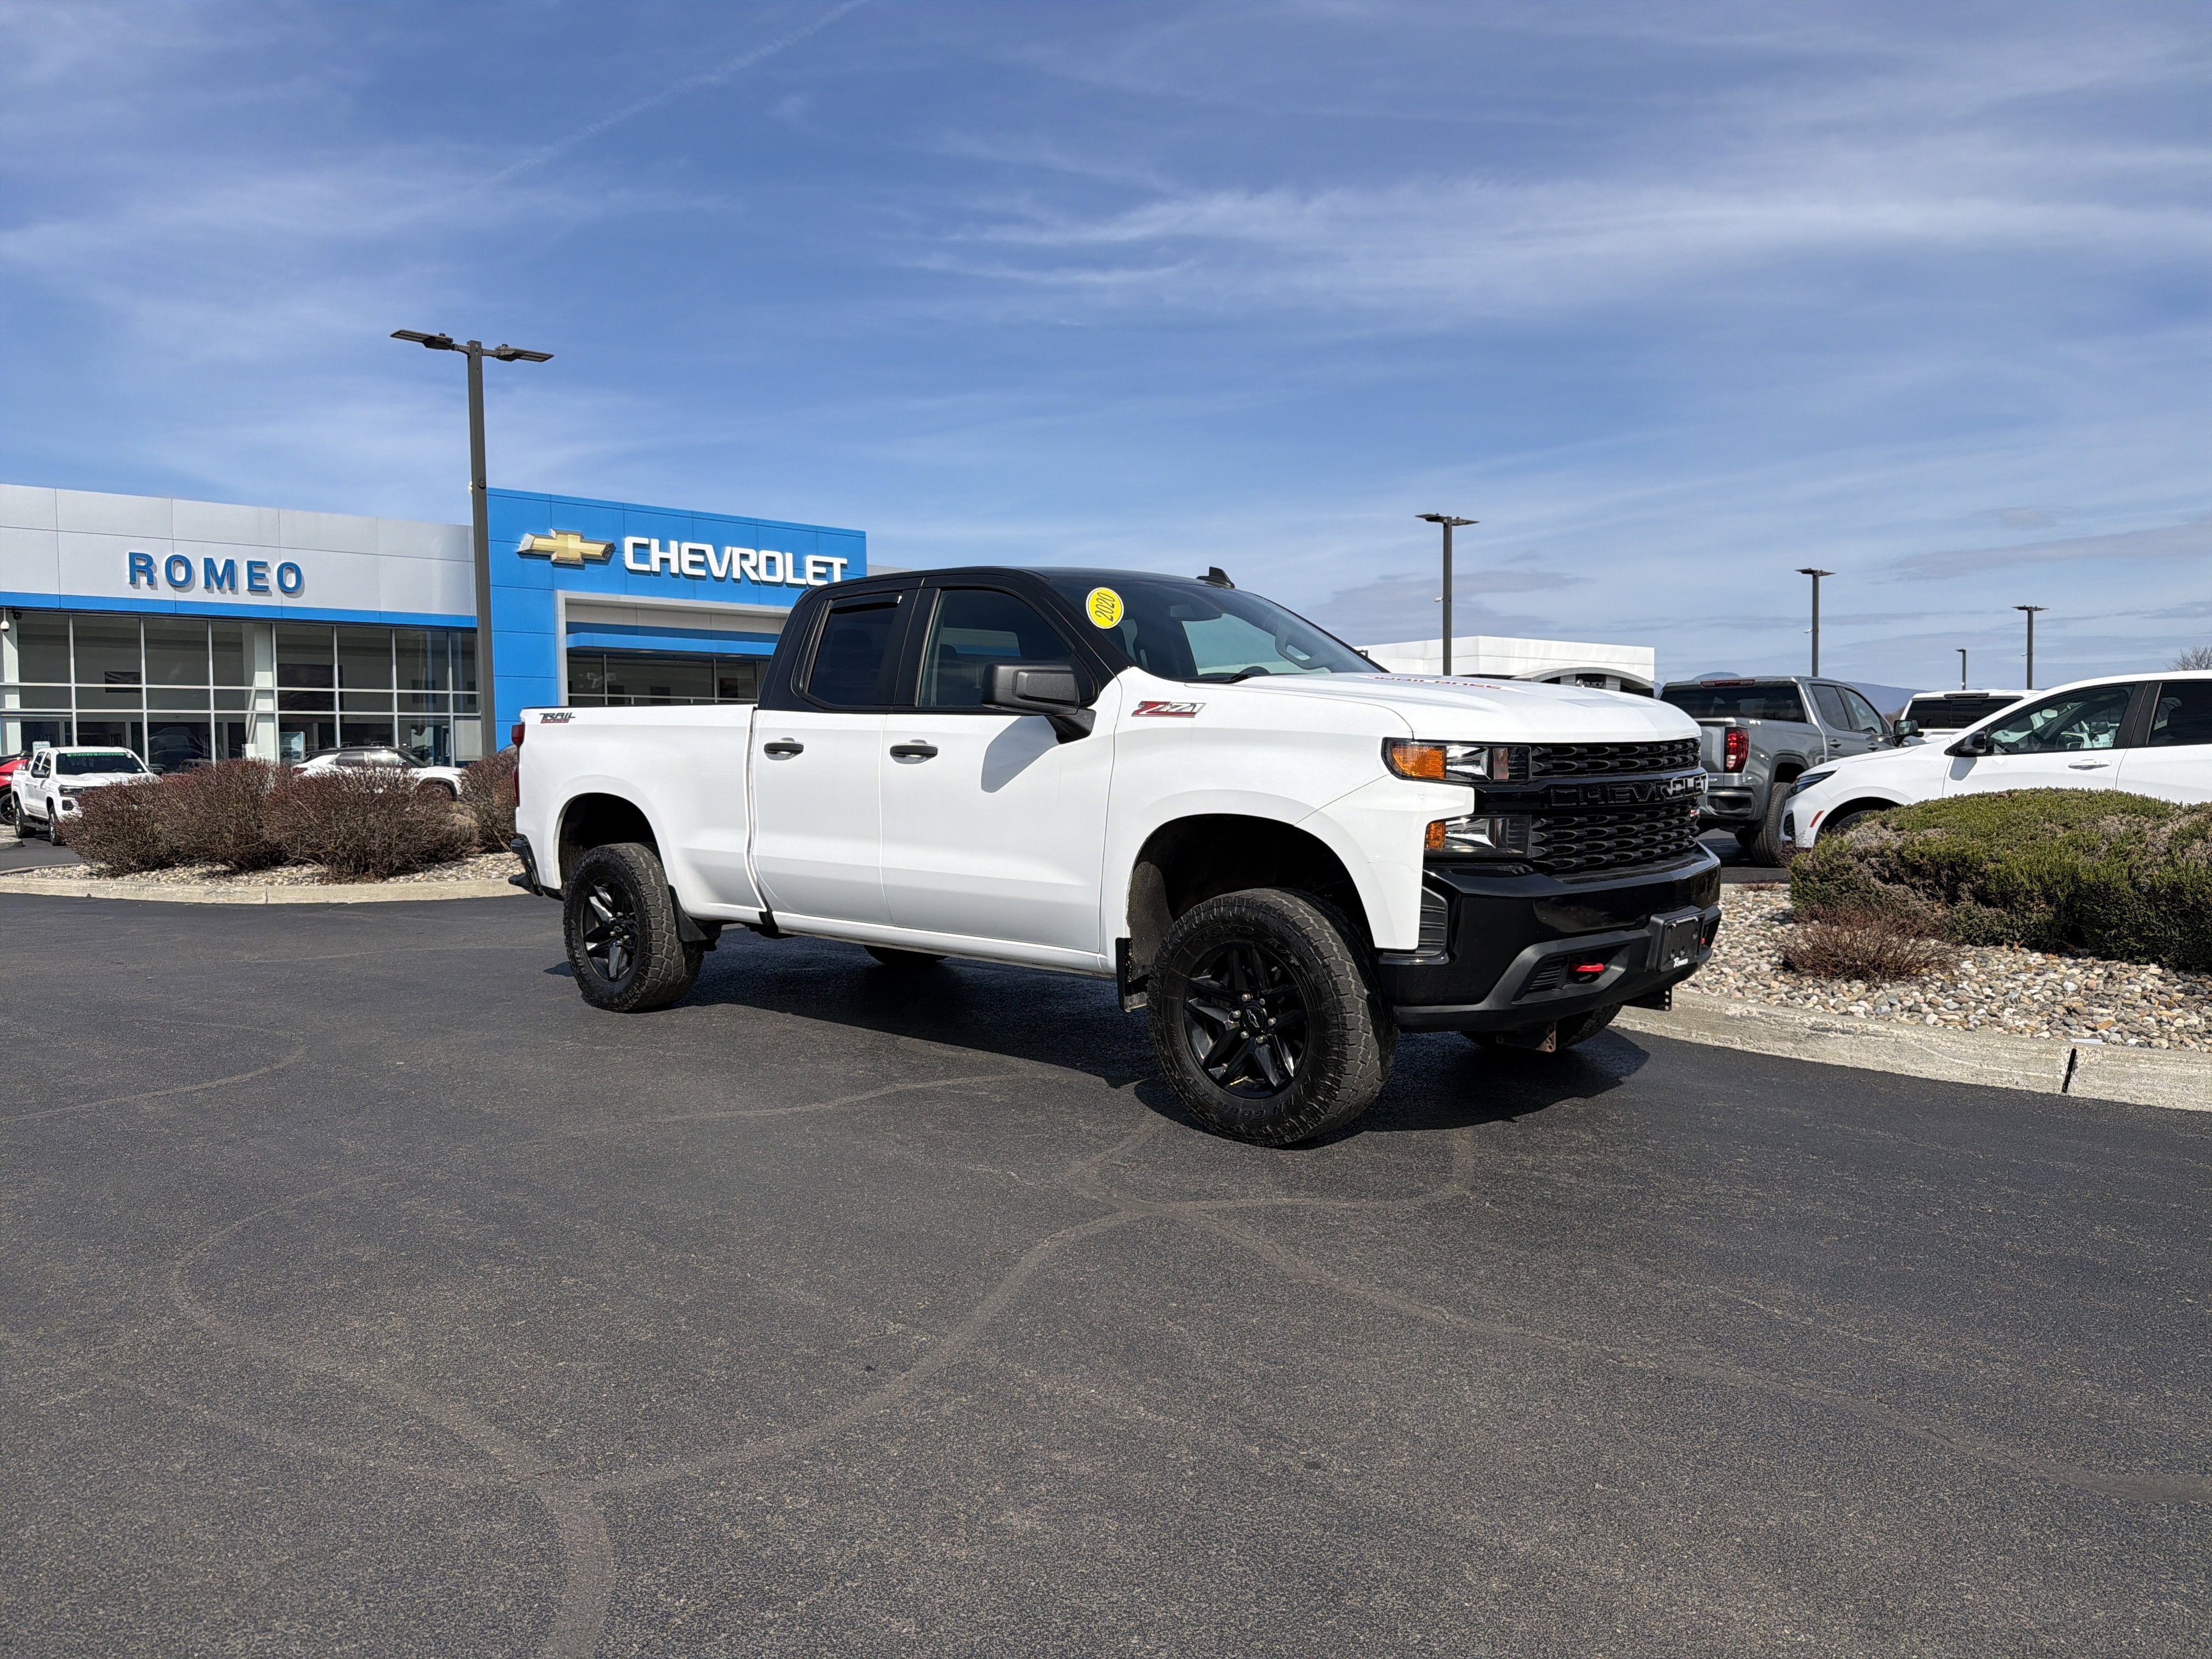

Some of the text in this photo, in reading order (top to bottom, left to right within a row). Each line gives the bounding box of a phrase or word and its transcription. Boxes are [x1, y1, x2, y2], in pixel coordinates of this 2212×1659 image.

[128, 551, 302, 593] ROMEO
[624, 536, 848, 586] CHEVROLET
[1094, 592, 1115, 622] 2020
[1131, 701, 1207, 718] Z71
[1550, 772, 1708, 806] CHEVROLET
